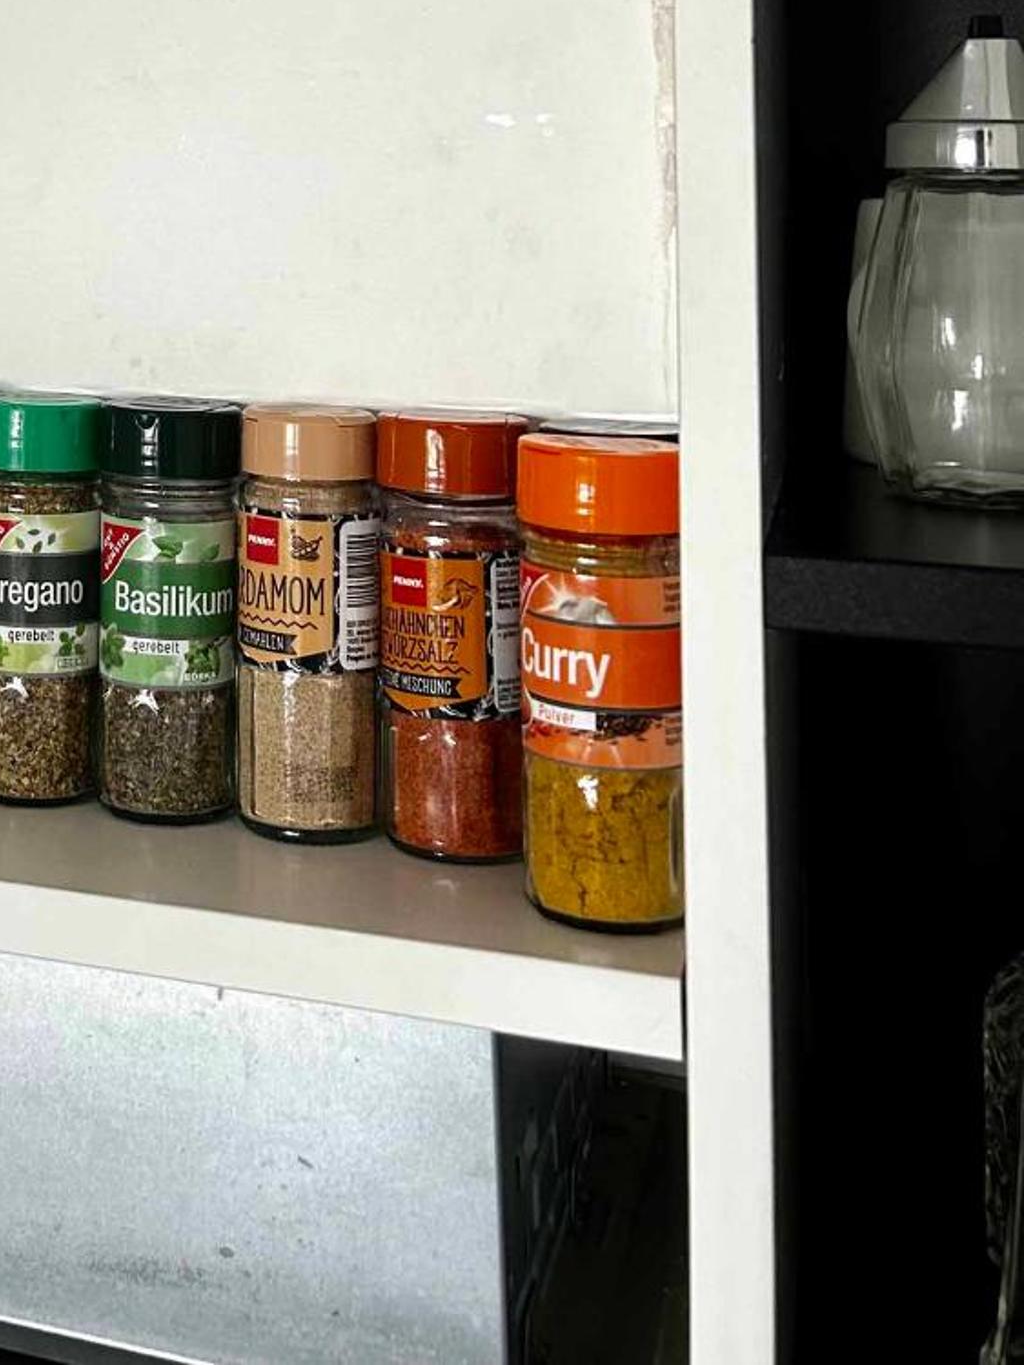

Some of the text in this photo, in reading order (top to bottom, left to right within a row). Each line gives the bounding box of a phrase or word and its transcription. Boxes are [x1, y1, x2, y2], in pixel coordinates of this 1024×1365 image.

[114, 580, 233, 617] Basilikum
[7, 626, 56, 642] gerebelt
[132, 640, 181, 654] gerebelt
[522, 627, 611, 699] Curry
[538, 704, 576, 725] Pulver
